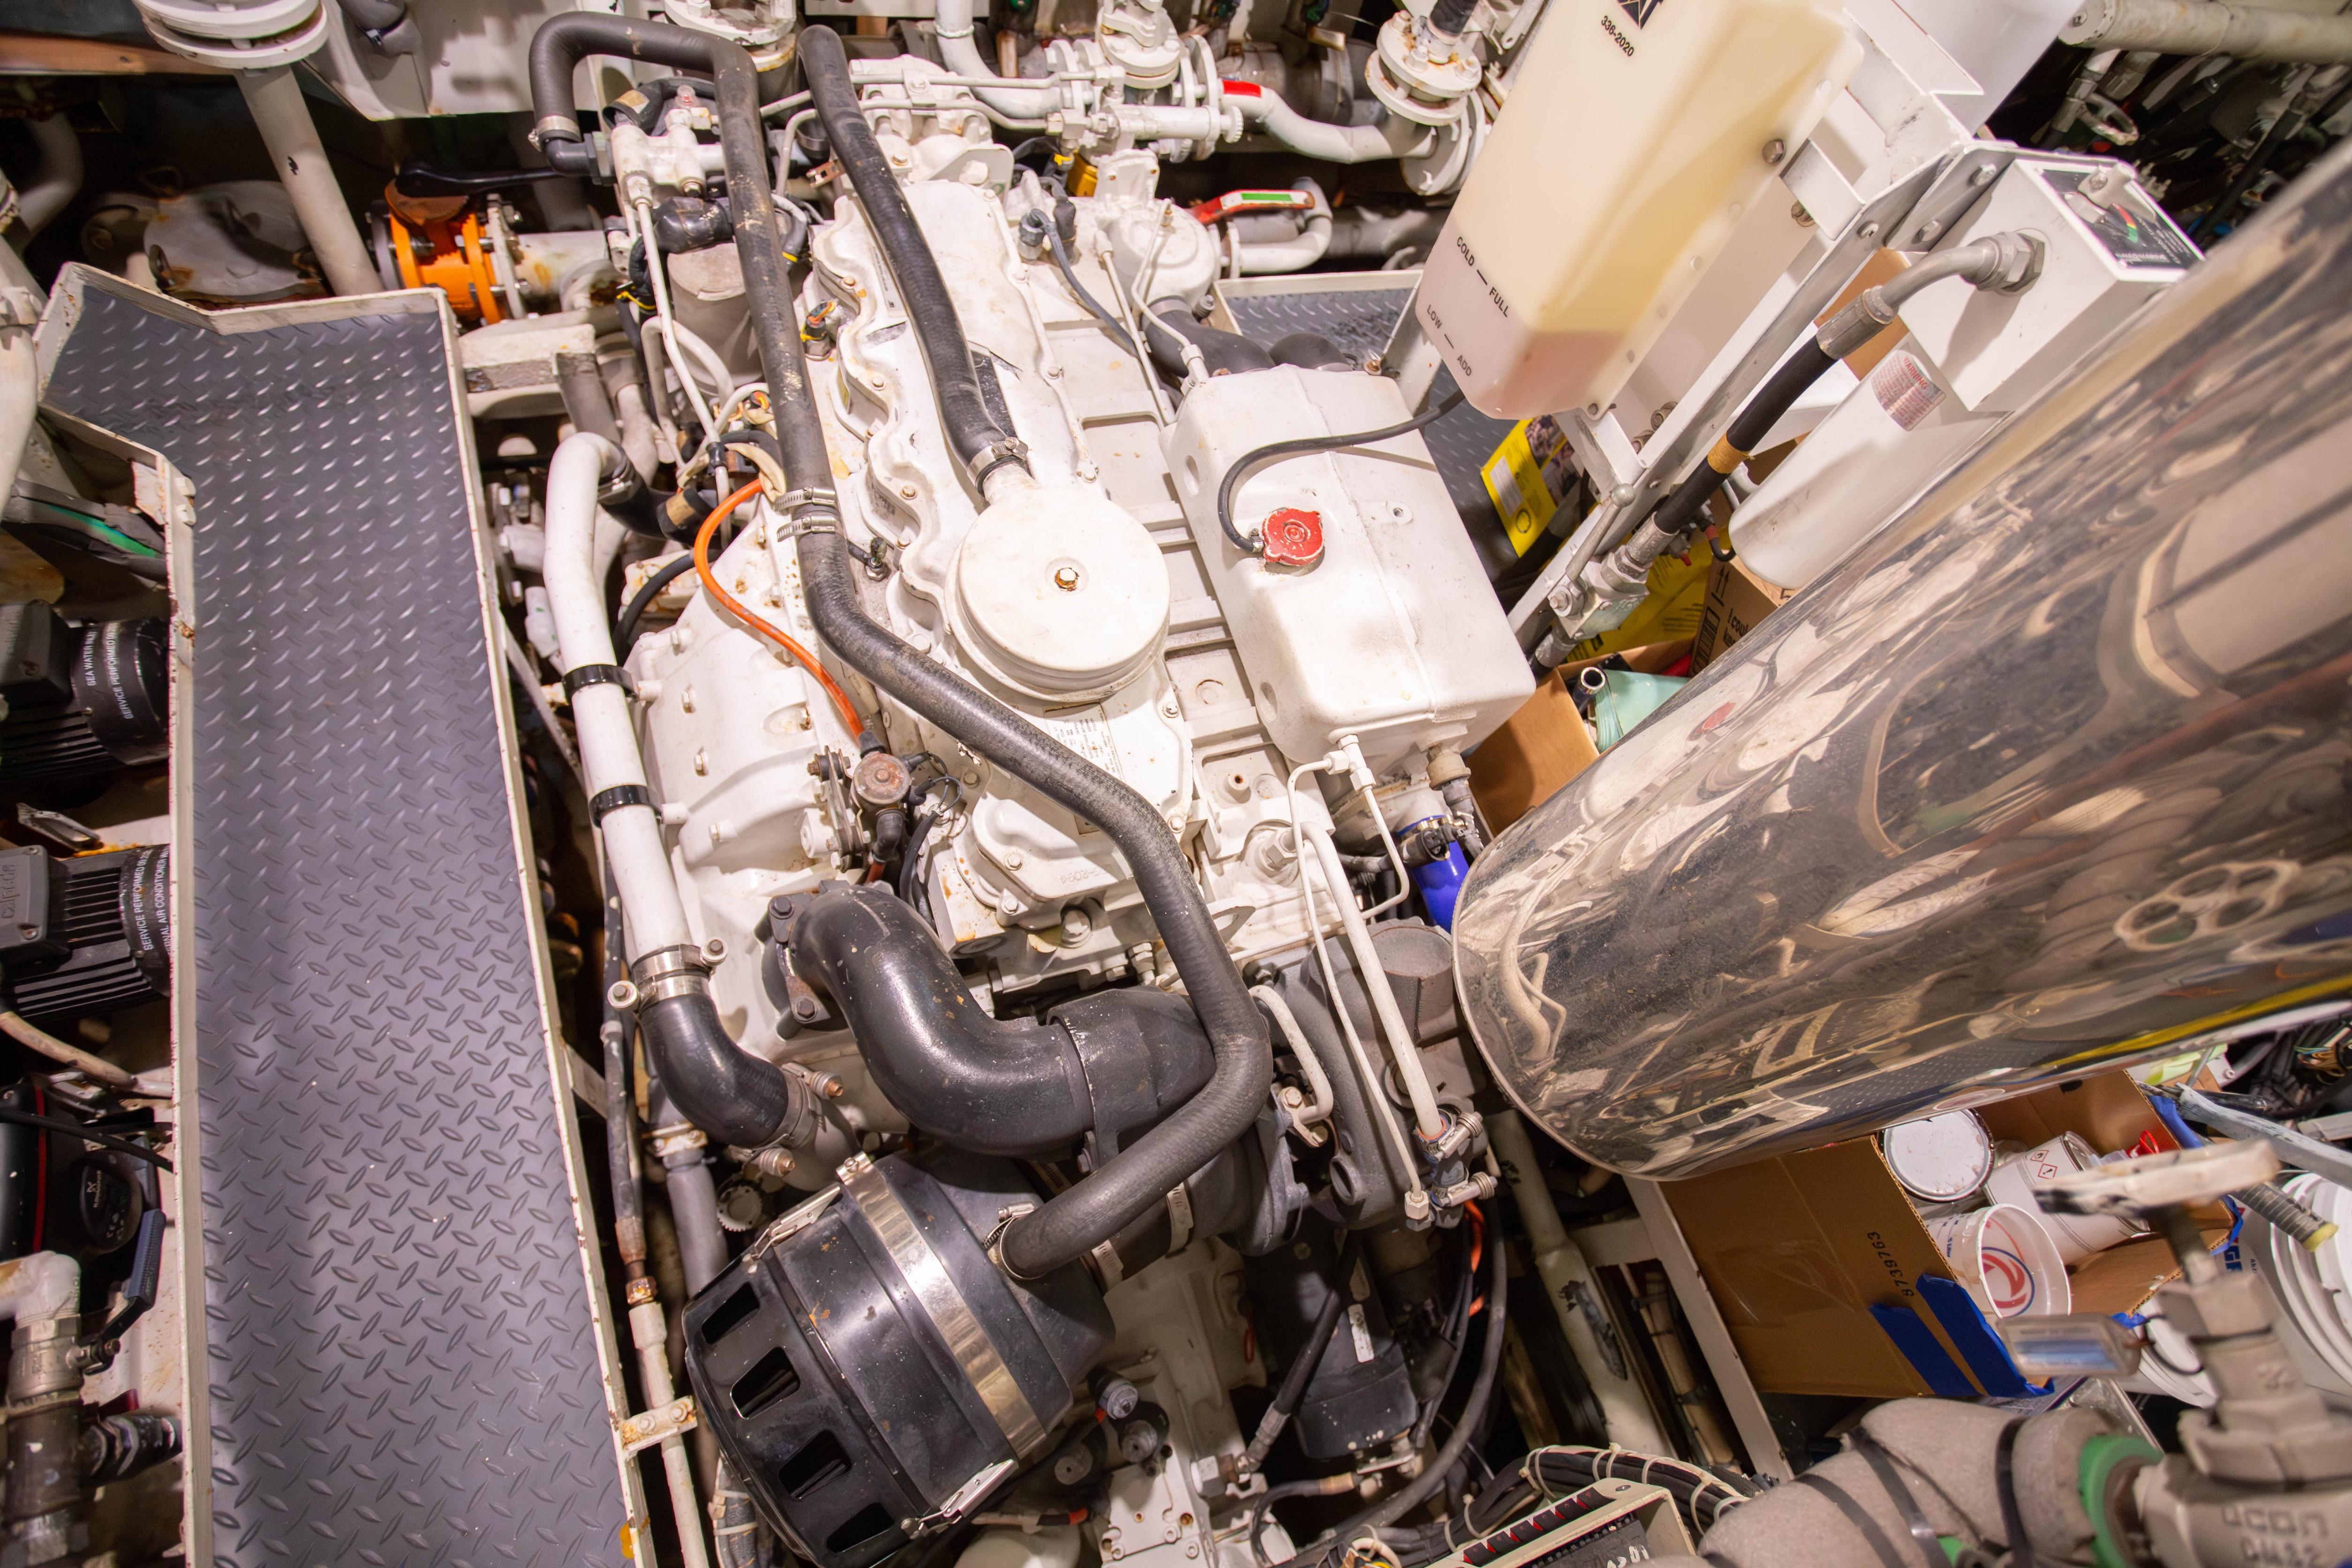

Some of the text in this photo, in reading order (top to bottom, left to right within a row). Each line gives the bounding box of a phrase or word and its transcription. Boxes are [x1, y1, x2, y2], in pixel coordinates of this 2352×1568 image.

[1601, 15, 1634, 56] 336-2020
[1457, 236, 1508, 317] COLD FULL
[1427, 304, 1471, 376] LOW ADD
[1903, 355, 1929, 390] WARNING
[83, 646, 94, 670] WATER
[106, 641, 120, 685] PERFORMED
[113, 686, 134, 719] SERVICE
[133, 867, 145, 913] PERFORMED
[154, 859, 167, 908] CONDITIONER
[136, 915, 154, 951] SERVICE
[156, 909, 168, 924] AIR
[1867, 1231, 1915, 1296] 8739763
